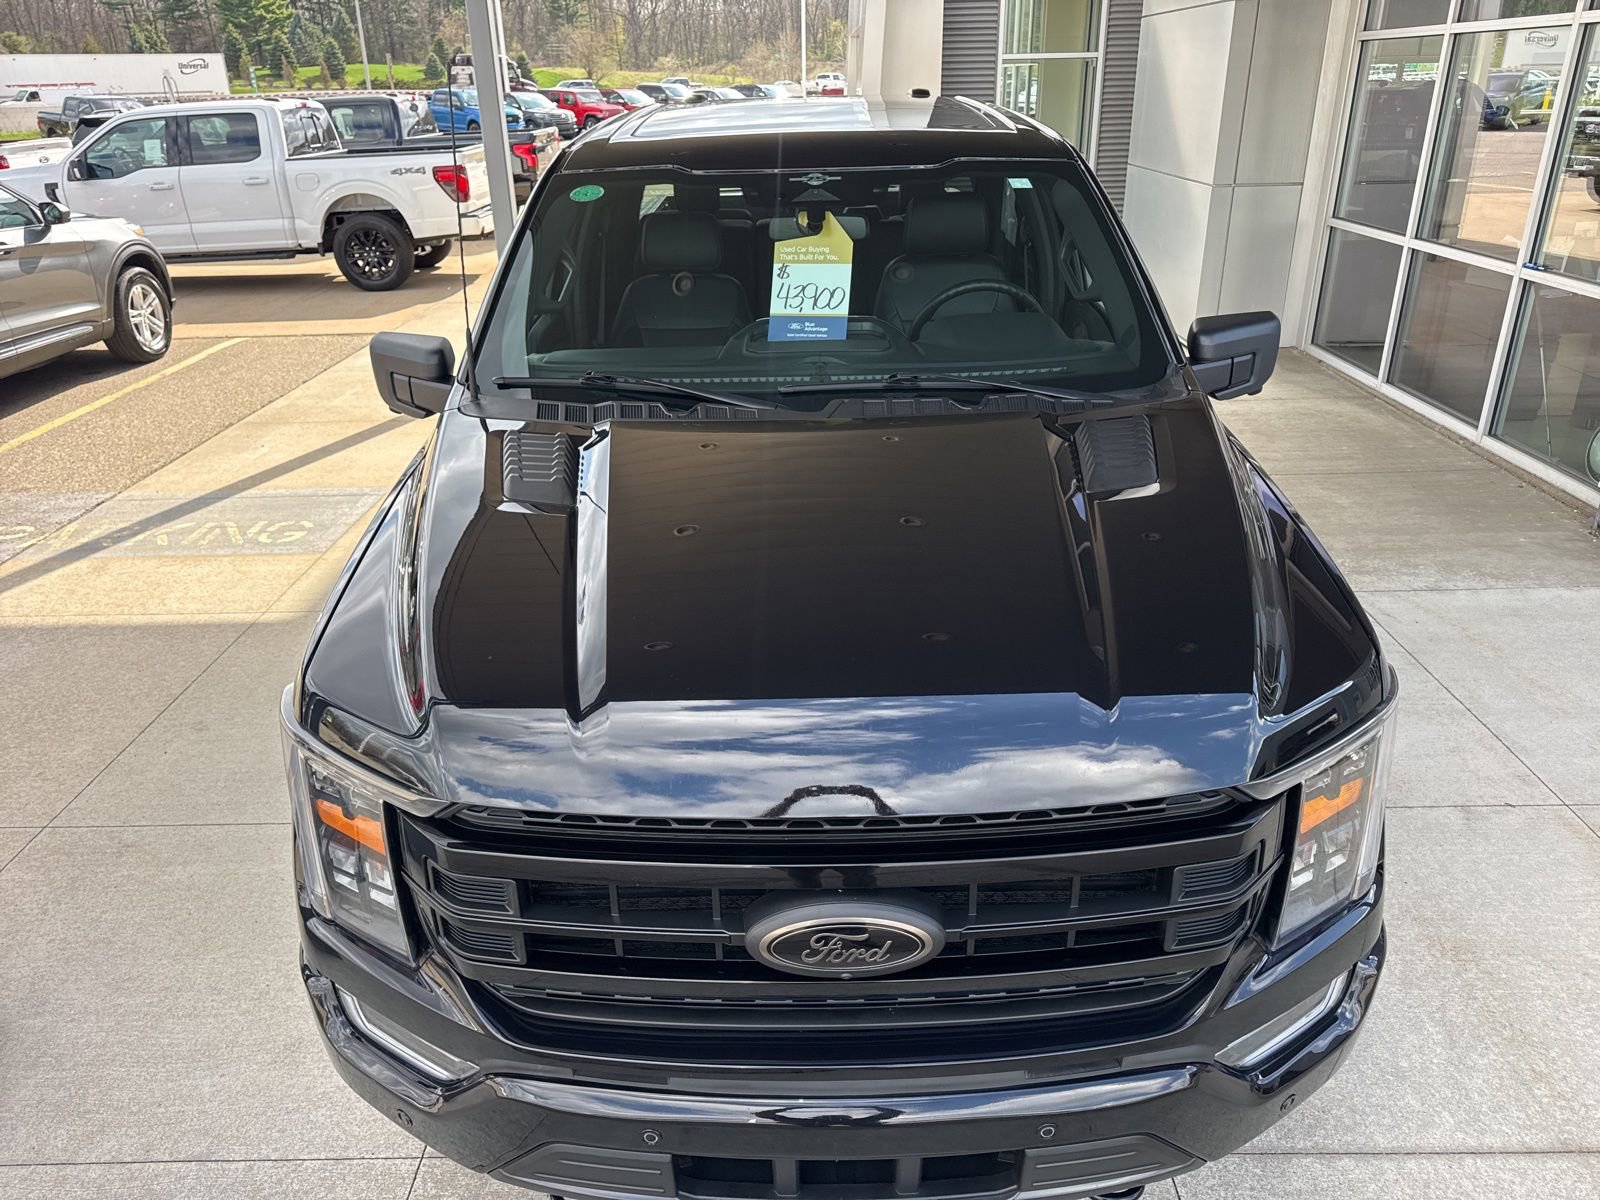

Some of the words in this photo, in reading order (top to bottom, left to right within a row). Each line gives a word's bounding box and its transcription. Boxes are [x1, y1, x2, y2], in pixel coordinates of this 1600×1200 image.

[178, 62, 209, 70] Universal
[808, 246, 830, 254] Buying
[776, 263, 790, 279] $
[776, 282, 846, 312] 43,900
[801, 932, 893, 964] Ford
